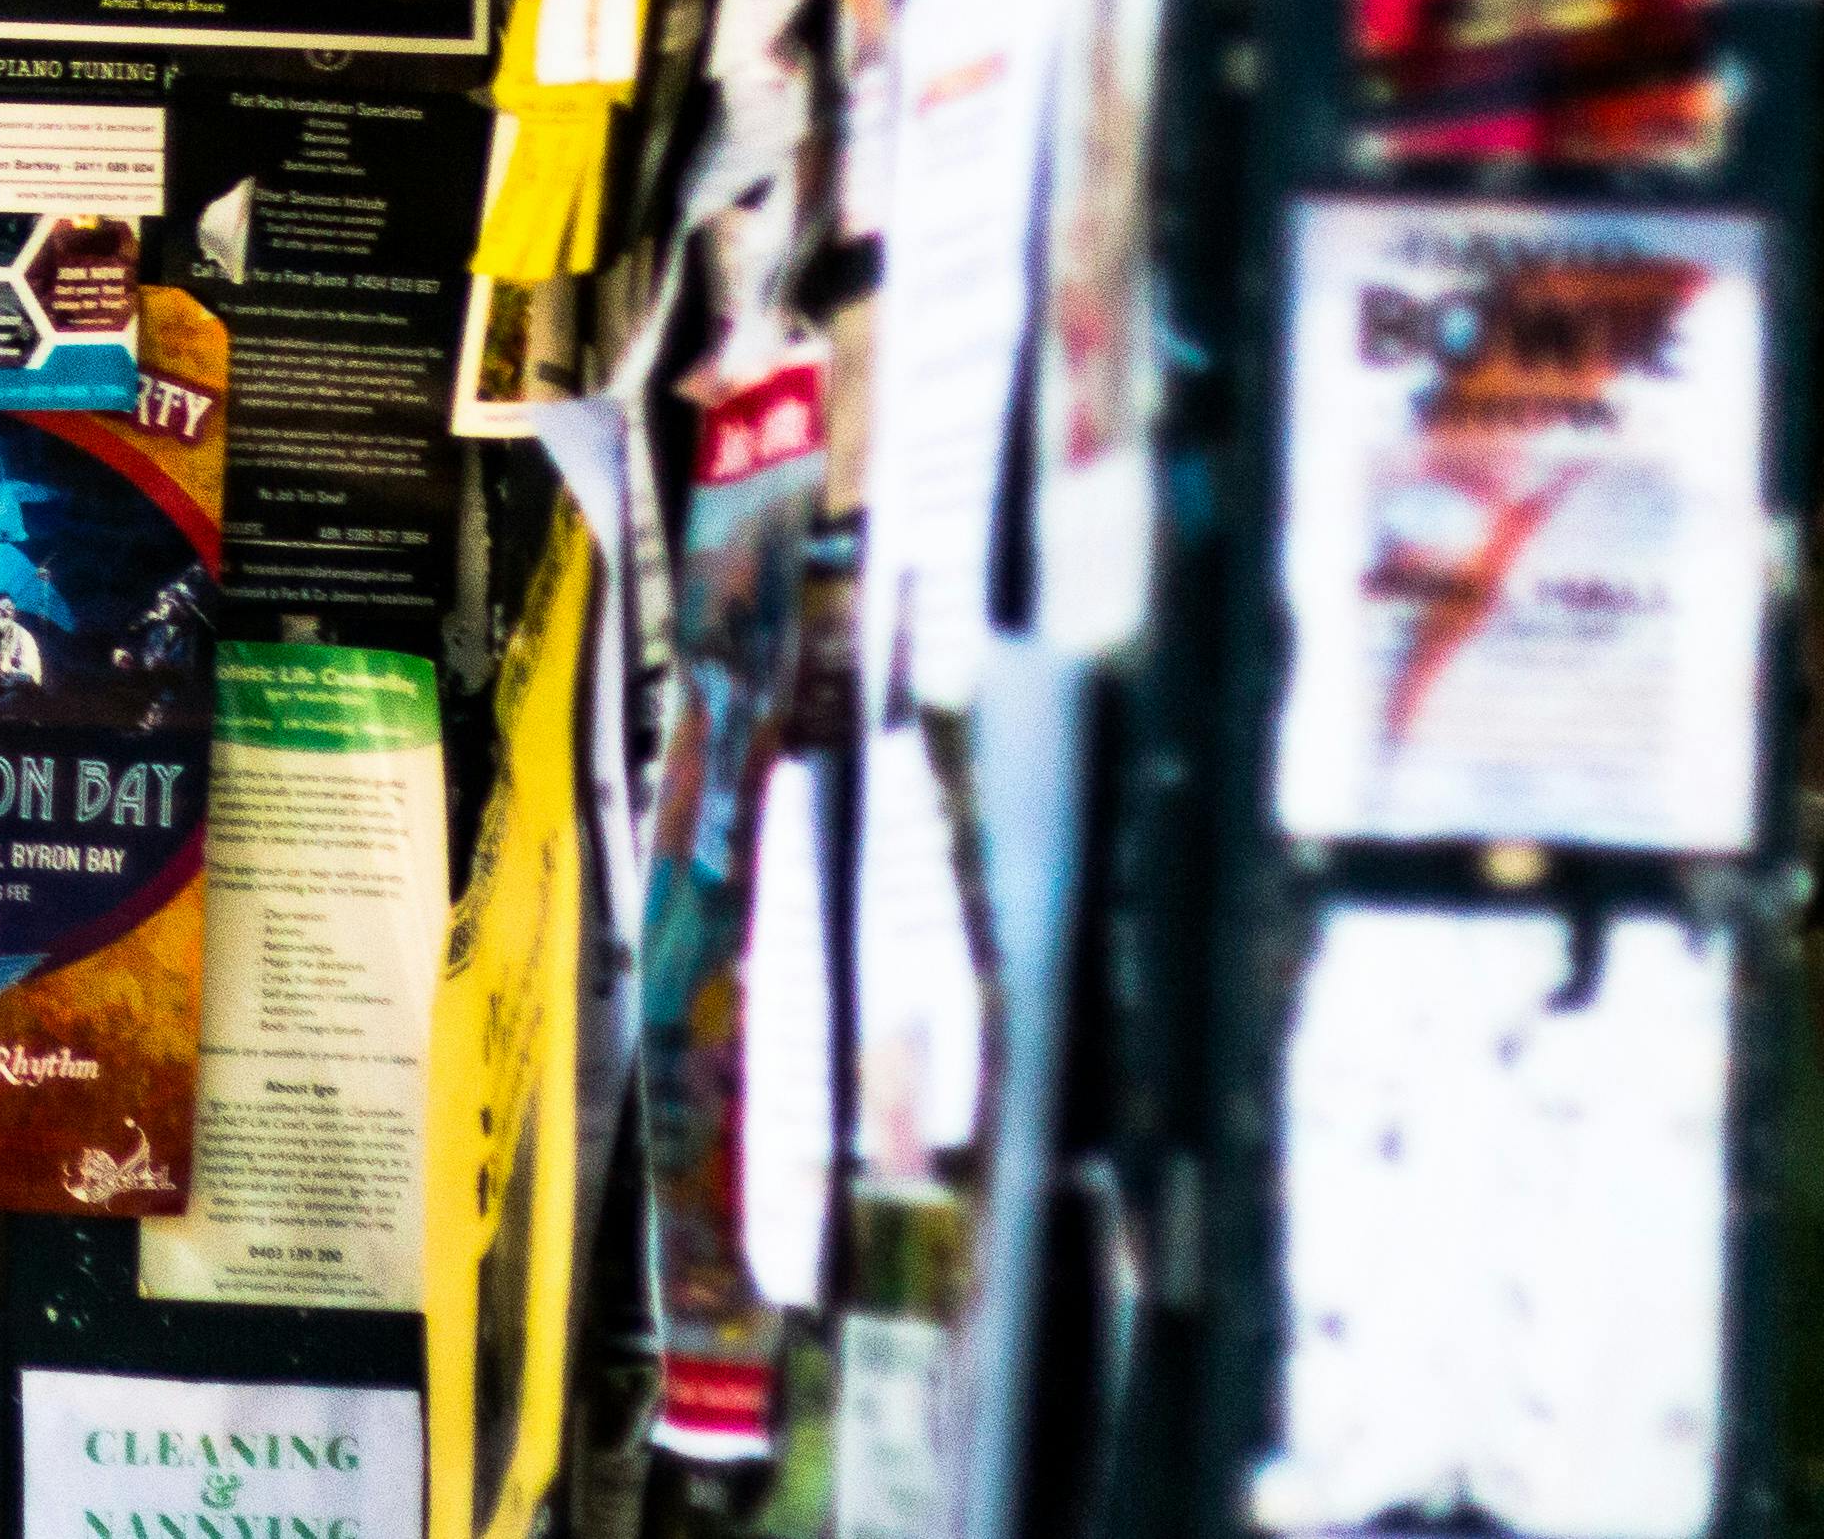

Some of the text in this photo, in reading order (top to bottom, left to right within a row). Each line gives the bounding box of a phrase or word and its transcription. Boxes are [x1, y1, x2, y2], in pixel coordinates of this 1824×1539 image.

[68, 60, 157, 83] TUNING
[75, 758, 184, 829] BAY
[84, 1428, 361, 1473] CLEANING
